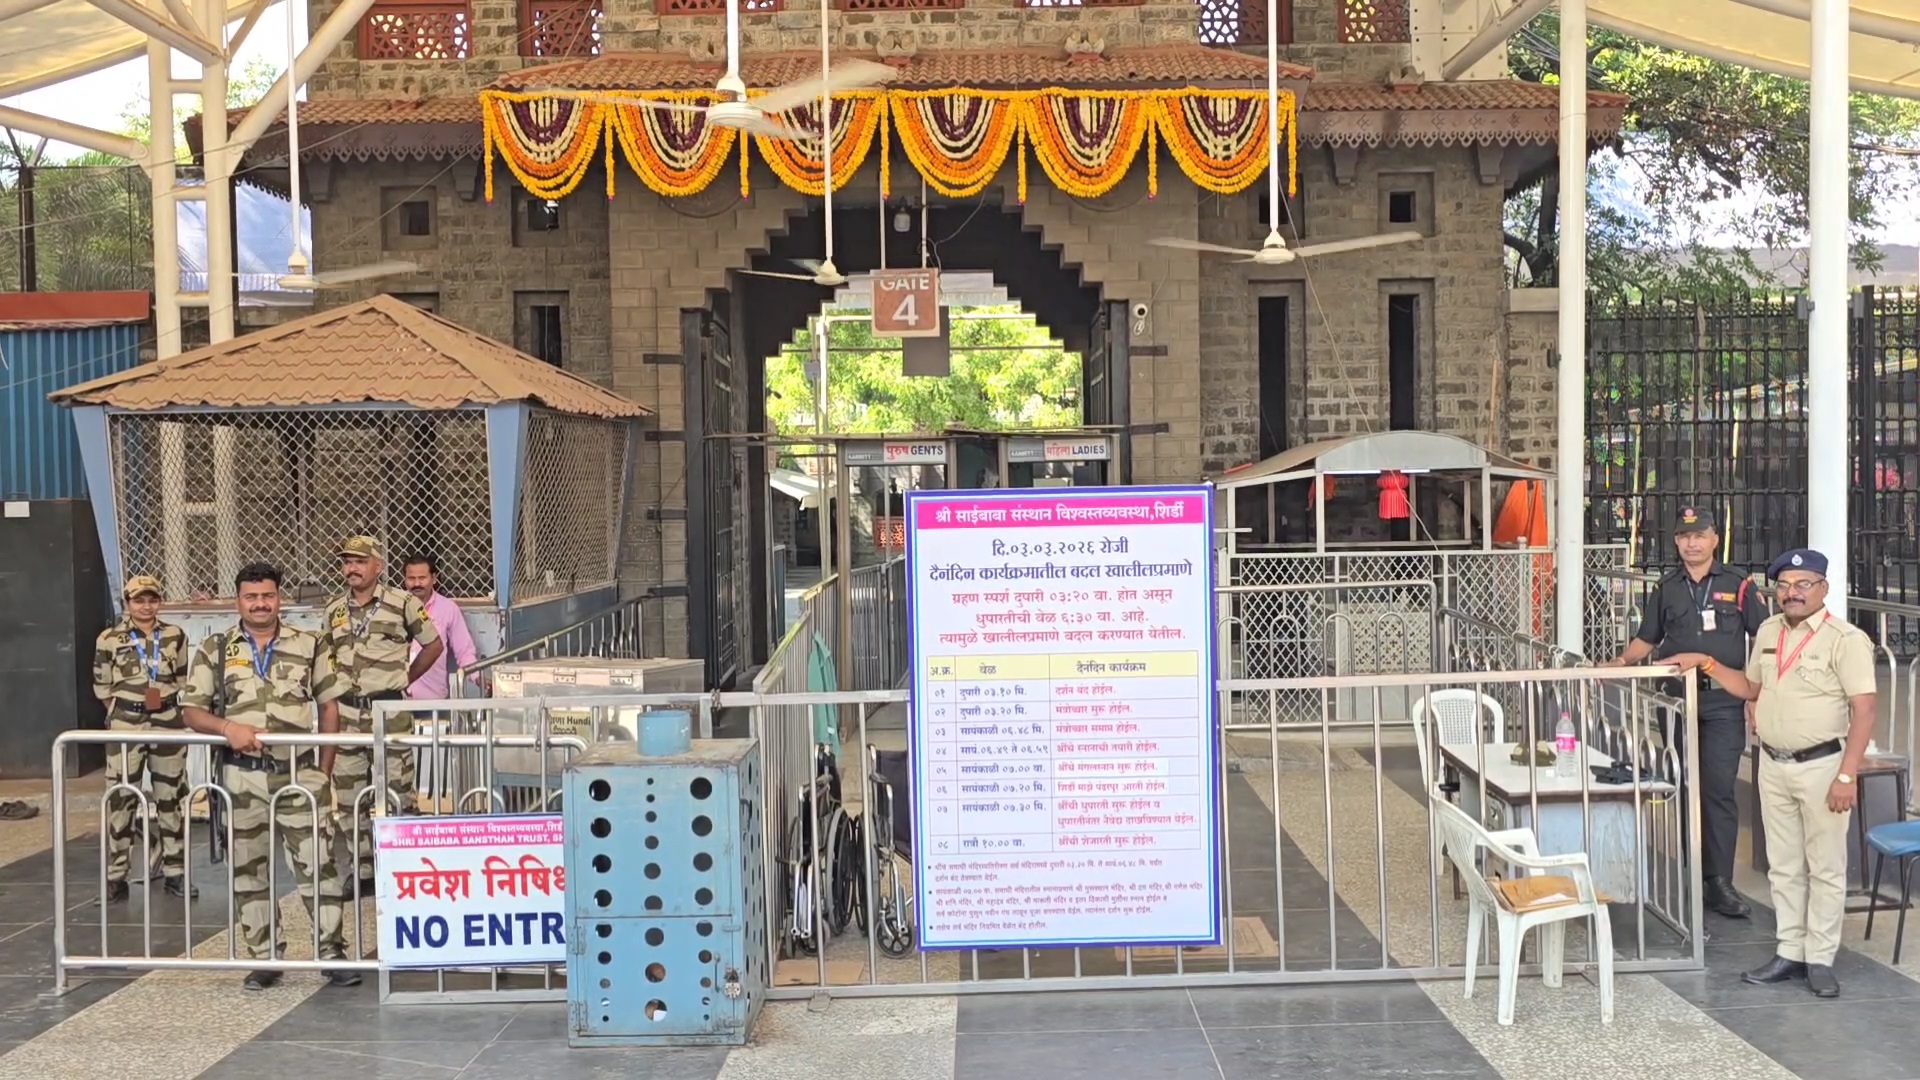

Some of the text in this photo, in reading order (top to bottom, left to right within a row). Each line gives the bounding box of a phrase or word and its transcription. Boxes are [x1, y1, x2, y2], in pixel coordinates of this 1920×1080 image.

[880, 273, 929, 291] GATE
[892, 294, 919, 326] 4
[886, 445, 943, 460] पुरुष GENTS
[1047, 443, 1104, 456] महिला LADIES
[935, 509, 951, 523] श्री
[955, 507, 1006, 525] साईबाबा
[1011, 505, 1052, 521] संस्थान
[992, 536, 1128, 557] दि.०३.०३.२०२६ रोजी
[929, 559, 1192, 582] दैनंदिन कार्यक्रमातील बदल खालीलप्रमाणे
[952, 586, 1173, 608] ग्रहण स्पर्श दुपारी ०३:२० वा. होत असून
[976, 607, 1148, 628] धुपारतीची वेळ ६:३० वा. आहे.
[940, 626, 1185, 648] त्यामुळे खालीलप्रमाणे बदल करण्यात येतील.
[979, 662, 996, 674] वेळ
[1077, 661, 1105, 674] दैनंदिन
[1109, 660, 1146, 672] कार्यक्रम
[960, 686, 980, 700] दुपारी
[1055, 683, 1073, 695] दर्शन
[1077, 685, 1089, 694] बंद
[1092, 683, 1116, 695] होईल.
[935, 709, 945, 717] ०२
[960, 706, 980, 720] दुपारी
[1109, 702, 1133, 713] होईल.
[567, 716, 591, 725] Hundi
[1116, 721, 1140, 733] होईल.
[1011, 743, 1017, 753] ते
[1136, 740, 1159, 752] होईल.
[1135, 760, 1158, 771] होईल.
[1146, 780, 1167, 791] होईल.
[1130, 797, 1151, 809] होईल
[425, 823, 456, 838] साईबाबा
[460, 823, 484, 834] संस्थान
[392, 837, 415, 846] SHRI
[418, 836, 460, 846] SAIBABA
[462, 835, 514, 845] SANSTHAN
[518, 834, 549, 843] TRUST,
[1133, 834, 1156, 845] होईल.
[392, 857, 471, 902] प्रवेश
[396, 912, 566, 949] NO ENTR
